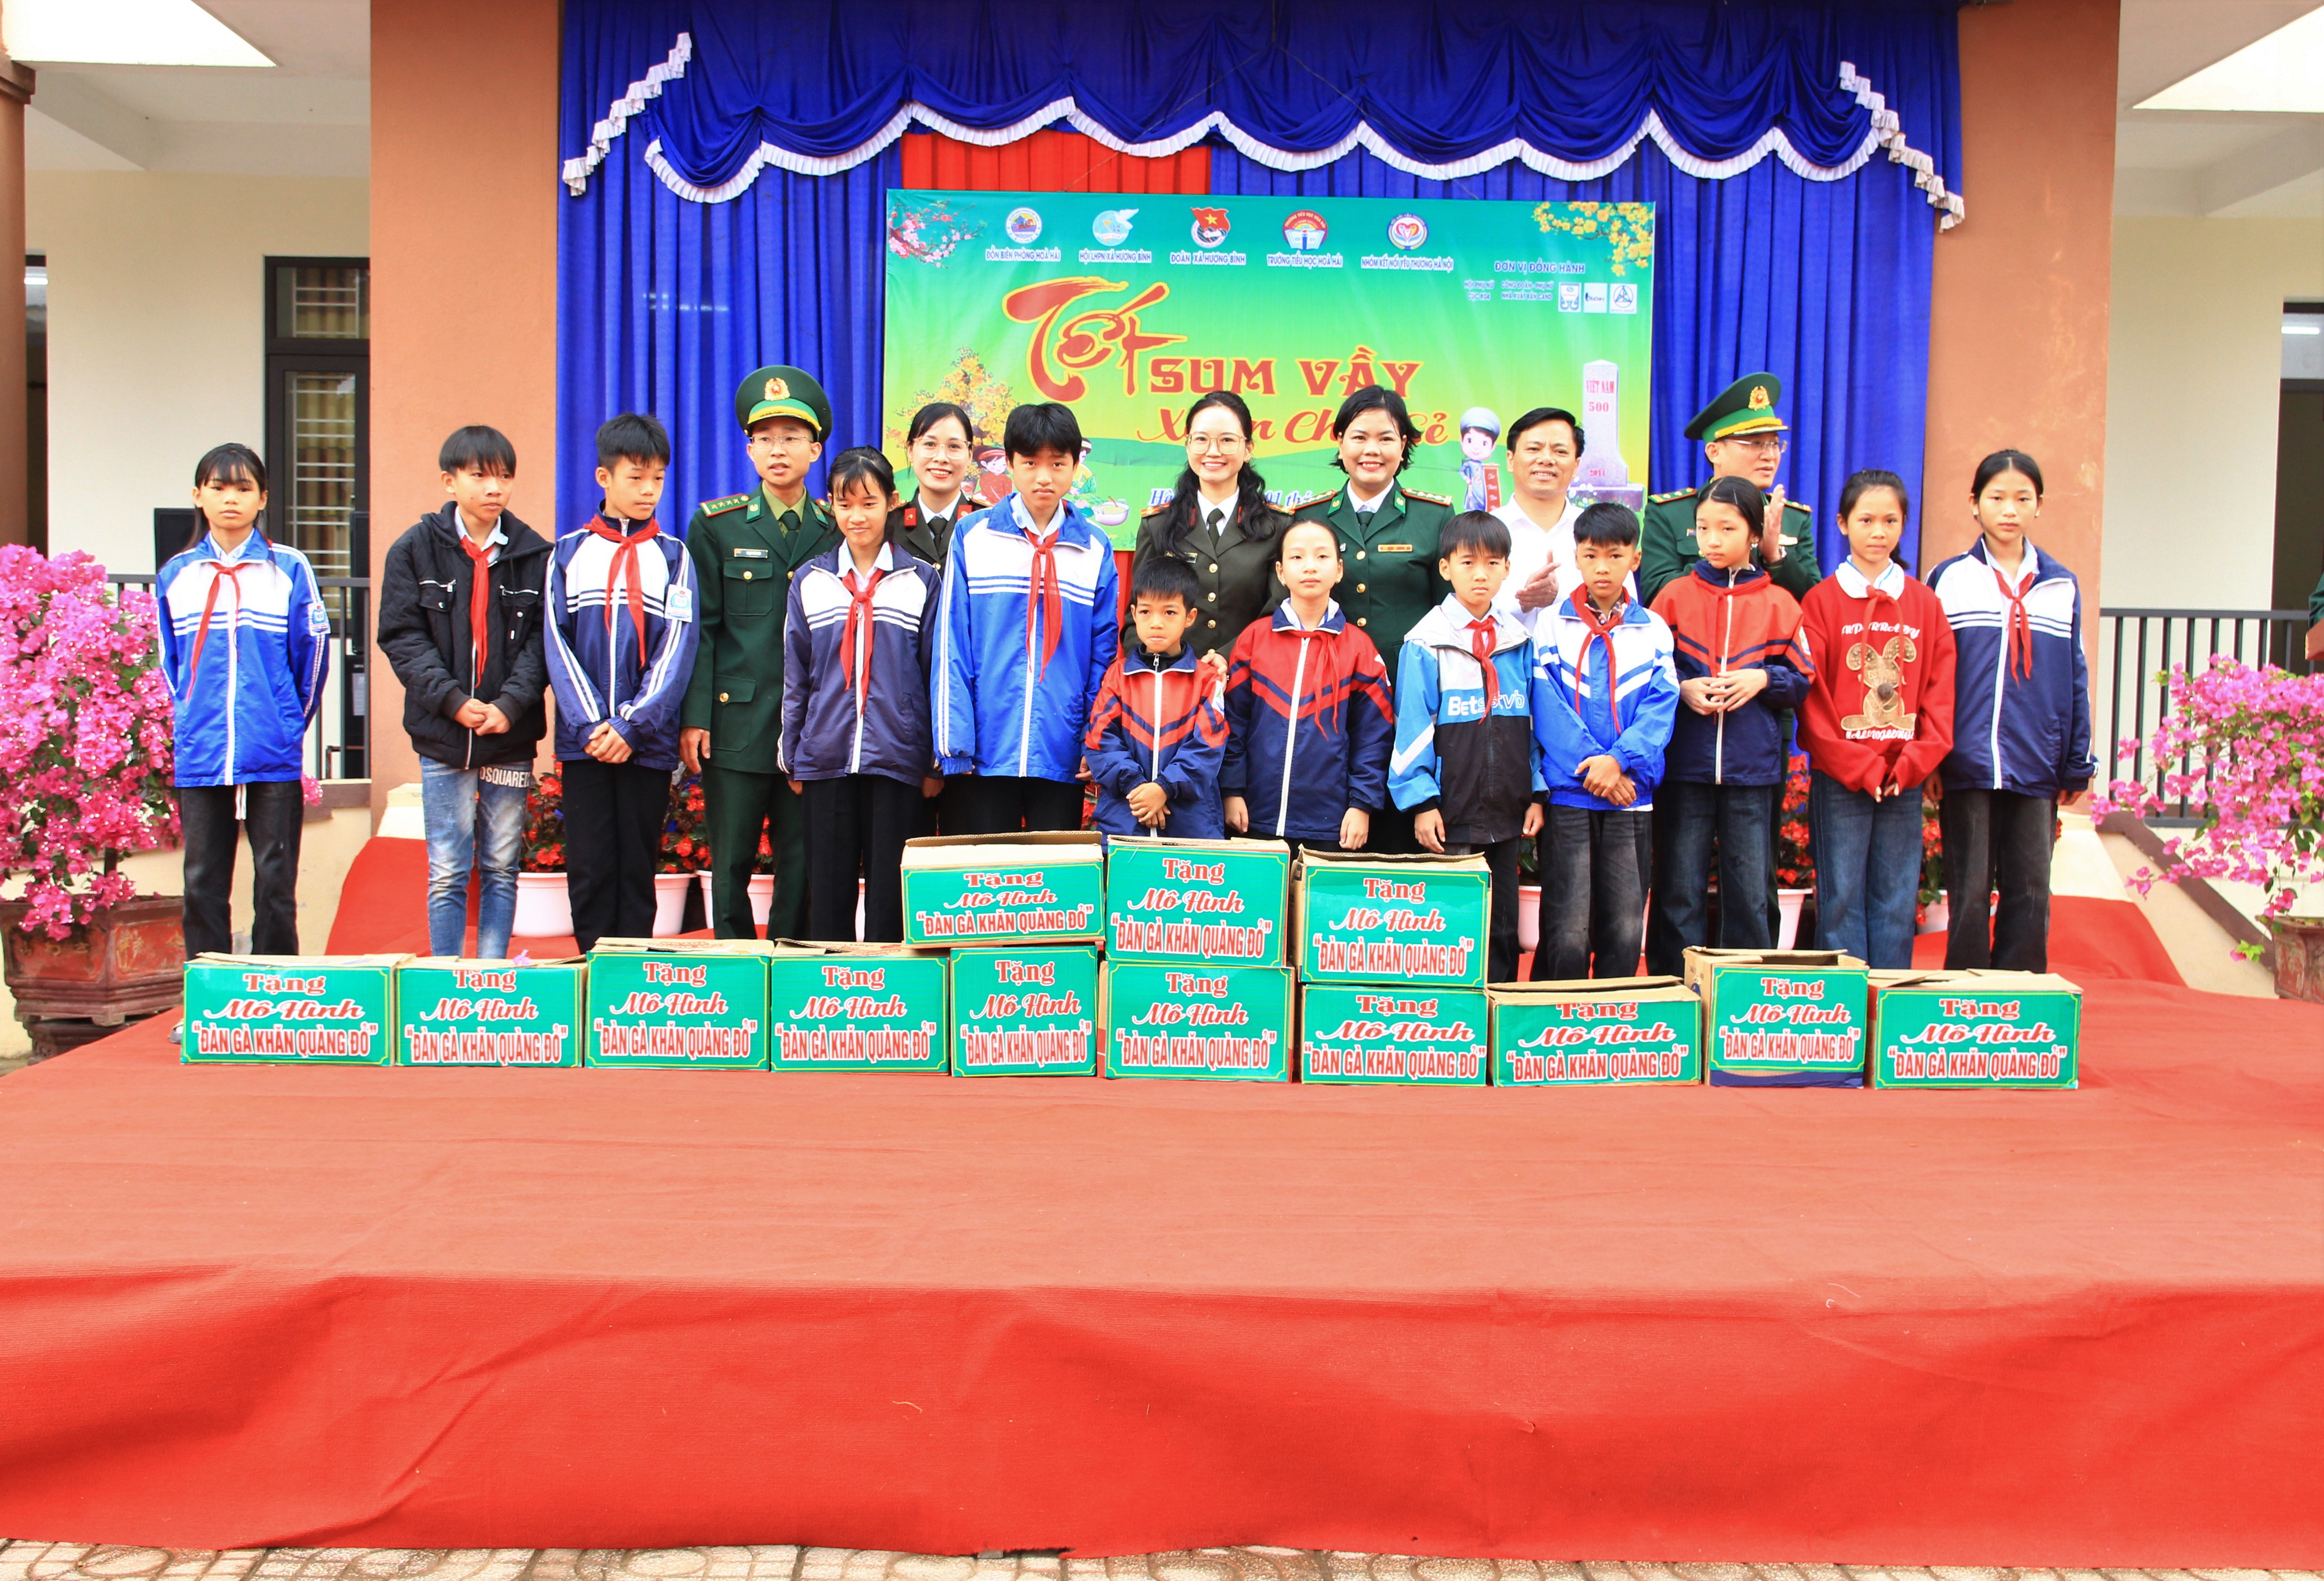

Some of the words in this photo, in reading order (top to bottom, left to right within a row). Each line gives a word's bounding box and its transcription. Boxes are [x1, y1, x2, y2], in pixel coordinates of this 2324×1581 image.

[1079, 248, 1090, 264] HỘI
[1091, 251, 1106, 262] LHPN
[1171, 251, 1190, 264] ĐOÀN
[1230, 252, 1245, 265] BÌNH
[1304, 255, 1317, 269] HỌC
[1434, 257, 1442, 270] HÀ
[1495, 261, 1515, 271] ĐƠN
[1518, 262, 1527, 274] VỊ
[1559, 261, 1585, 274] HÀNH
[1003, 275, 1188, 401] Tết
[1150, 358, 1276, 394] SUM
[1296, 346, 1422, 397] VẦY
[1601, 381, 1614, 393] NAM
[1589, 401, 1609, 412] 500
[964, 873, 1043, 887] Tặng
[1164, 858, 1224, 884] Tặng
[945, 892, 994, 908] Mô
[996, 889, 1057, 906] Hình
[1128, 889, 1184, 911] Mô
[1183, 891, 1244, 913] Hình
[1364, 878, 1425, 903] Tặng
[957, 911, 976, 934] GÀ
[979, 912, 1015, 933] KHĂN
[1019, 910, 1064, 934] QUÀNG
[1330, 908, 1382, 930] Mô
[1384, 908, 1445, 931] Hình
[1146, 917, 1162, 952] GÀ
[1165, 920, 1199, 954] KHĂN
[1203, 920, 1245, 958] QUÀNG
[1349, 936, 1366, 972] GÀ
[1369, 939, 1402, 974] KHĂN
[1404, 938, 1447, 977] QUÀNG
[244, 974, 325, 995] Tặng
[454, 970, 516, 991] Tặng
[644, 962, 706, 986] Tặng
[822, 967, 884, 989] Tặng
[1166, 973, 1227, 997] Tặng
[1762, 977, 1824, 998] Tặng
[204, 1000, 278, 1019] Mô
[281, 1000, 364, 1019] Hình
[420, 998, 474, 1019] Mô
[475, 998, 538, 1019] Hình
[609, 993, 664, 1015] Mô
[664, 992, 728, 1015] Hình
[790, 997, 843, 1018] Mô
[845, 996, 907, 1018] Hình
[1133, 1004, 1186, 1024] Mô
[1187, 1003, 1248, 1025] Hình
[1356, 995, 1437, 1018] Tặng
[1557, 1002, 1638, 1020] Tặng
[1731, 1004, 1785, 1023] Mô
[1788, 1004, 1850, 1023] Hình
[1940, 999, 2019, 1019] Tặng
[232, 1025, 252, 1053] GÀ
[254, 1026, 294, 1054] KHĂN
[298, 1026, 346, 1057] QUÀNG
[630, 1021, 649, 1055] GÀ
[651, 1023, 685, 1056] KHĂN
[687, 1022, 730, 1059] QUÀNG
[1316, 1020, 1389, 1040] Mô
[1391, 1021, 1474, 1041] Hình
[1519, 1026, 1590, 1047] Mô
[1593, 1023, 1676, 1043] Hình
[1901, 1026, 1973, 1044] Mô
[1974, 1023, 2055, 1043] Hình
[441, 1028, 459, 1061] GÀ
[461, 1028, 496, 1062] KHĂN
[497, 1028, 540, 1065] QUÀNG
[810, 1025, 828, 1060] GÀ
[830, 1026, 865, 1060] KHĂN
[867, 1025, 910, 1062] QUÀNG
[1151, 1031, 1168, 1066] GÀ
[1170, 1033, 1204, 1067] KHĂN
[1207, 1032, 1250, 1069] QUÀNG
[1751, 1028, 1766, 1060] GÀ
[1768, 1029, 1797, 1060] KHĂN
[1799, 1028, 1835, 1063] QUÀNG
[1344, 1045, 1365, 1075] GÀ
[1367, 1047, 1405, 1077] KHĂN
[1407, 1047, 1456, 1079] QUÀNG
[1547, 1051, 1566, 1080] GÀ
[1568, 1051, 1607, 1079] KHĂN
[1610, 1050, 1658, 1080] QUÀNG
[1929, 1048, 1947, 1078] GÀ
[1949, 1050, 1988, 1078] KHĂN
[1991, 1048, 2039, 1080] QUÀNG
